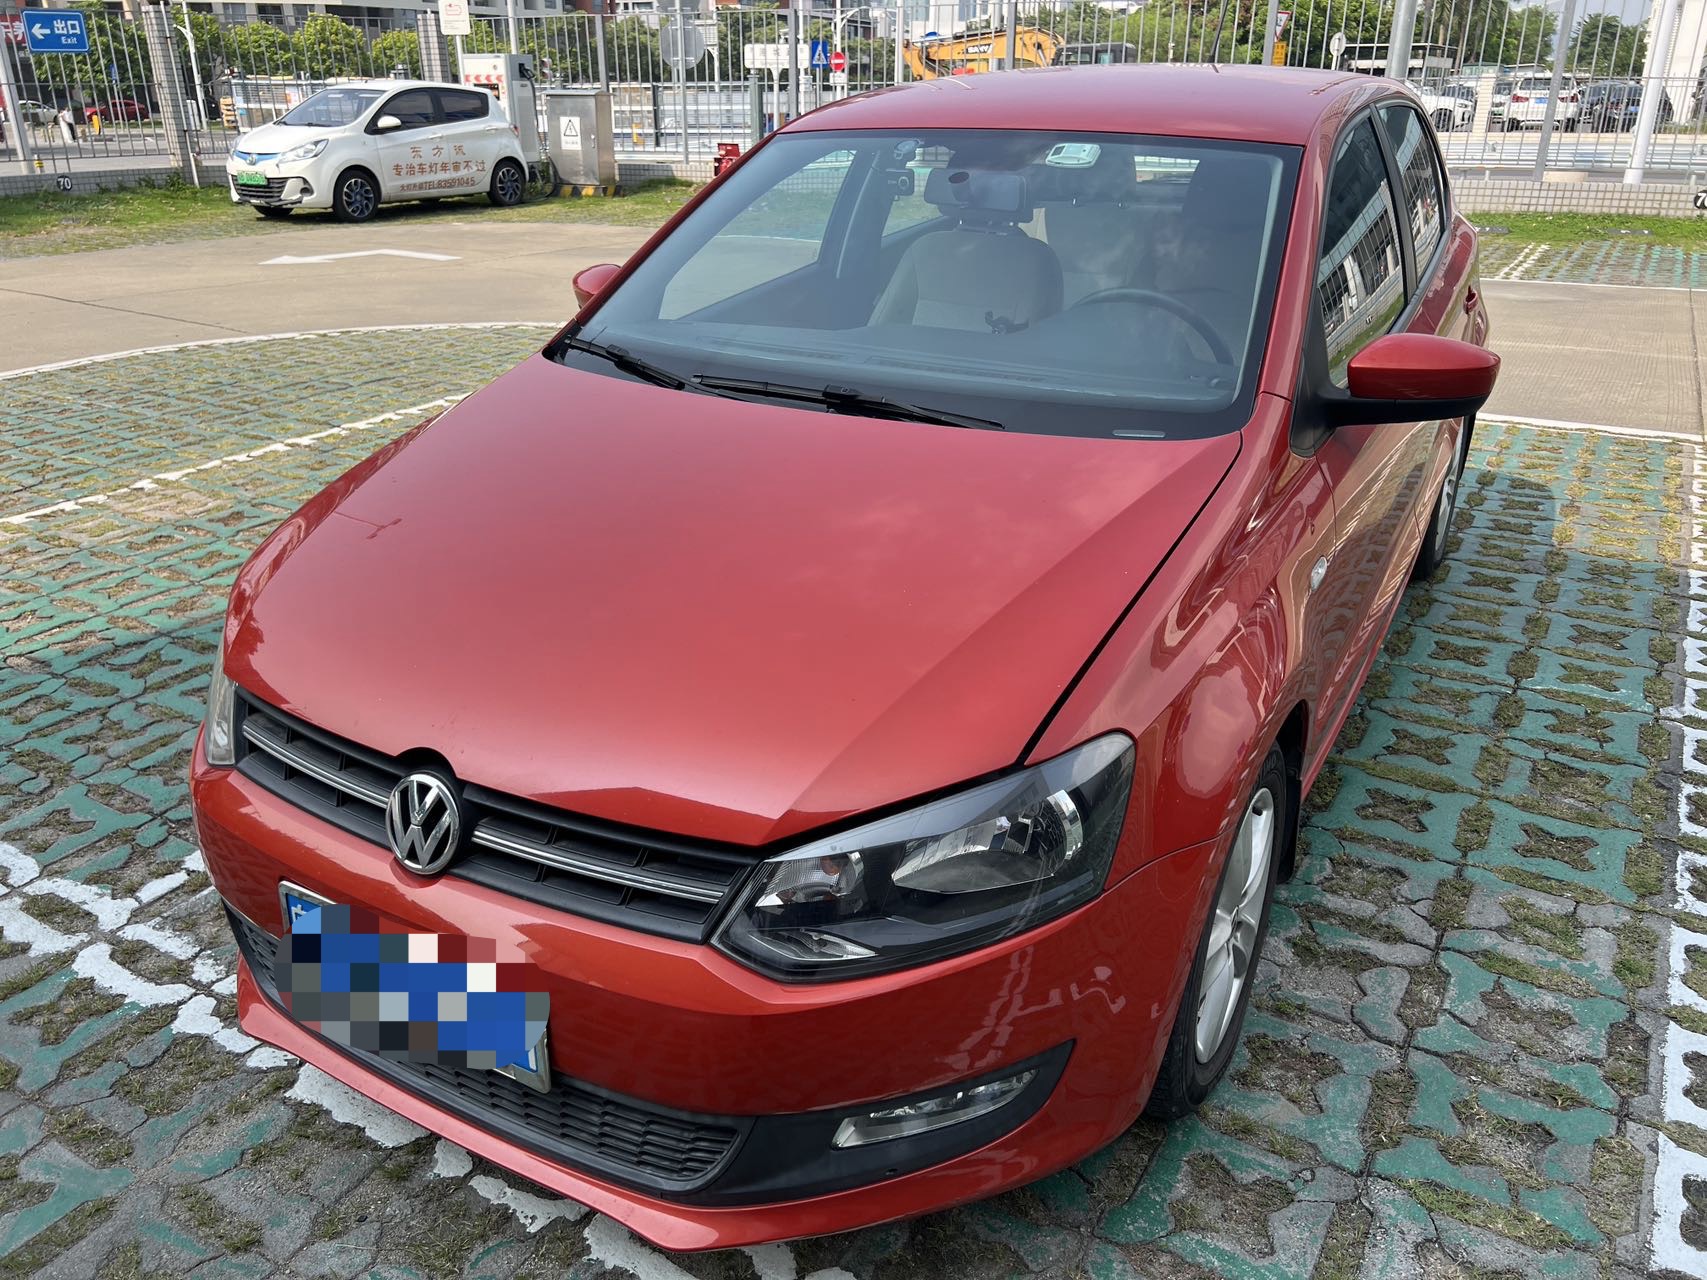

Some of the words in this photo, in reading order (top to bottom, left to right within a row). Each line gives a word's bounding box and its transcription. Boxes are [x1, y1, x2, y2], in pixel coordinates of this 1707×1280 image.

[53, 19, 81, 35] 出口
[61, 36, 78, 44] Exit
[392, 160, 487, 177] 专治车灯年审不过
[57, 177, 71, 190] 70
